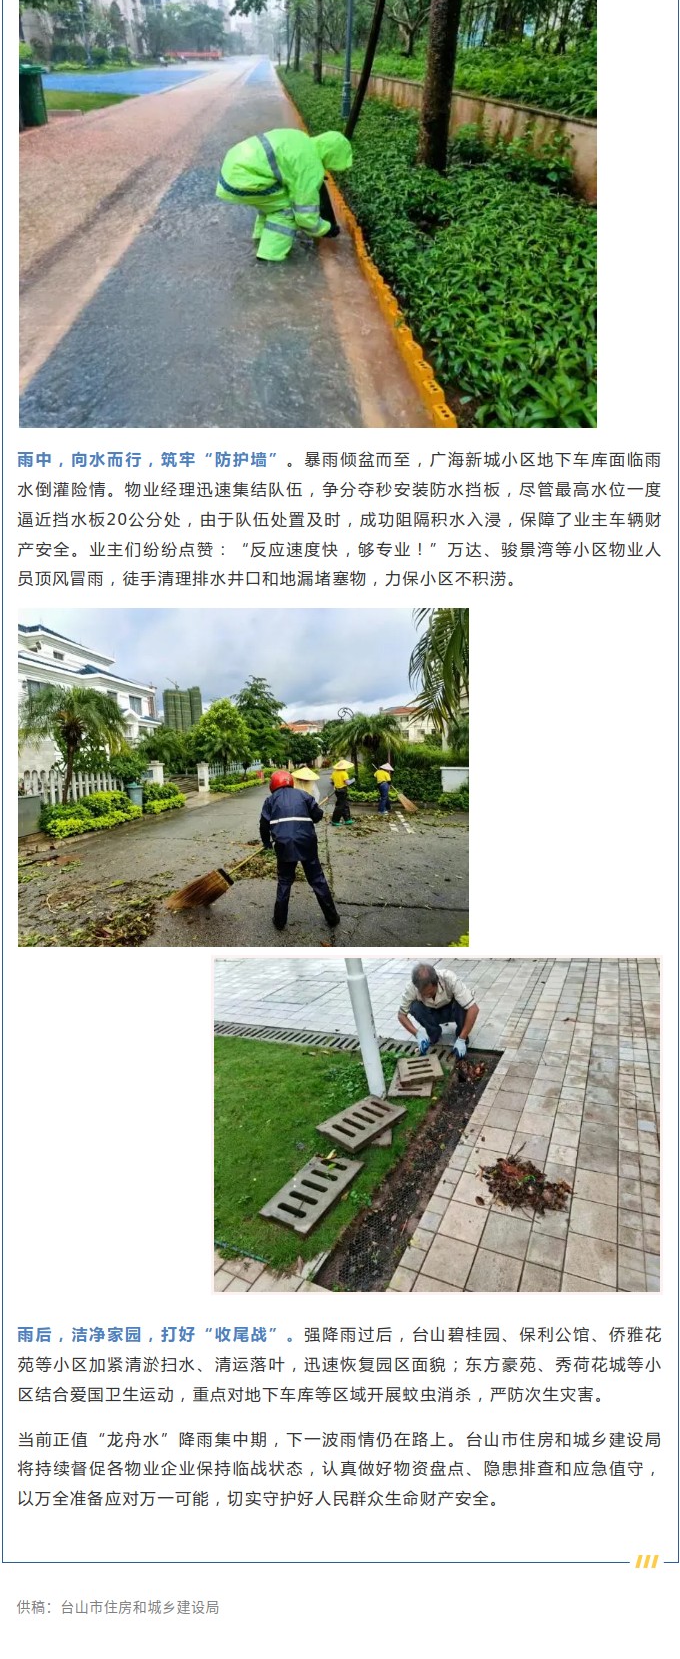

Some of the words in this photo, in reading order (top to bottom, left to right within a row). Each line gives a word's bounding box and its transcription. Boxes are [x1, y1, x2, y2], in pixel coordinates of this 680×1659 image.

[17, 480, 662, 498] 水倒灌险情。物业经理迅速集结队伍，争分夺秒安装防水挡板，尽管最高水位一度
[17, 569, 516, 587] 员顶风冒雨，徒手清理排水井口和地漏堵塞物，力保小区不积涝。
[17, 1355, 662, 1373] 苑等小区加紧清淤扫水、清运落叶，迅速恢复园区面貌；东方豪苑、秀荷花城等小
[18, 1385, 604, 1403] 区结合爱国卫生运动，重点对地下车库等区域开展蚊虫消杀，严防次生灾害。
[17, 1459, 656, 1477] 将持续督促各物业企业保持临战状态，认真做好物资盘点、隐患排查和应急值守，
[18, 1489, 498, 1507] 以万全准备应对万一可能，切实守护好人民群众生命财产安全。
[16, 1599, 219, 1615] 供稿：台山市住房和城乡建设局
